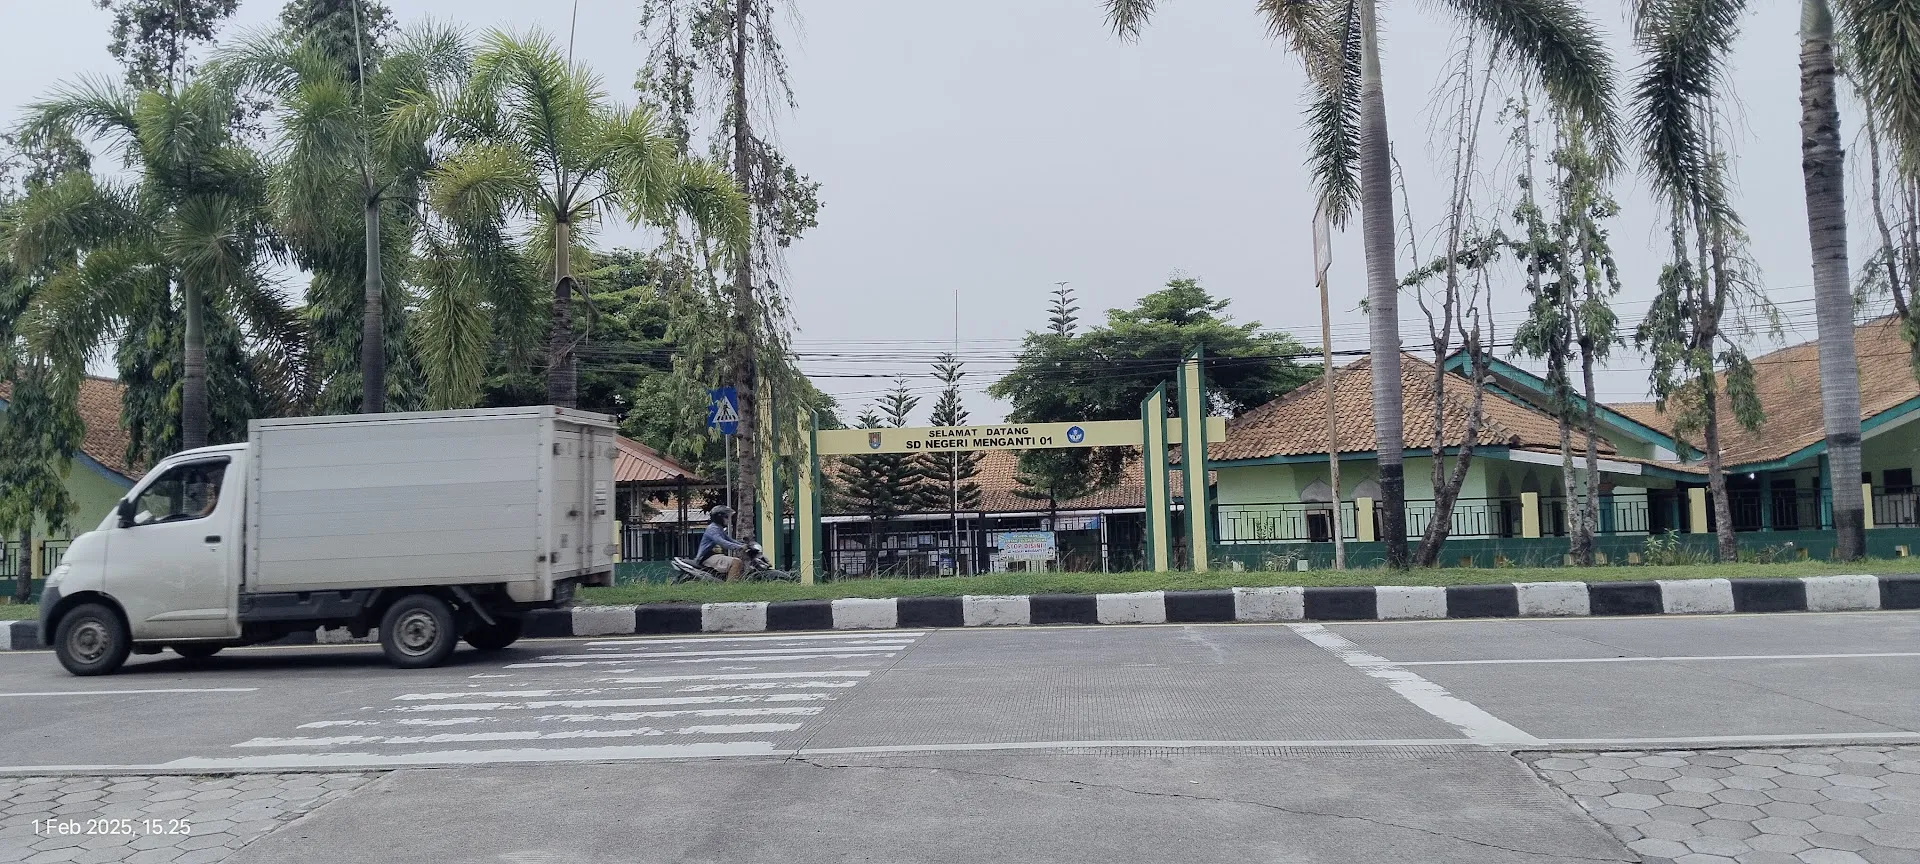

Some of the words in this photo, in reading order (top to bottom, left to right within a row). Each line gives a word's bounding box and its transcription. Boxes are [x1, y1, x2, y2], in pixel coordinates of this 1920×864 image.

[929, 429, 977, 438] SELAMAT
[986, 427, 1029, 436] DATANG
[906, 440, 921, 449] SD
[925, 439, 968, 449] NEGERI
[973, 437, 1035, 448] MENGANTI
[1039, 436, 1053, 445] 01
